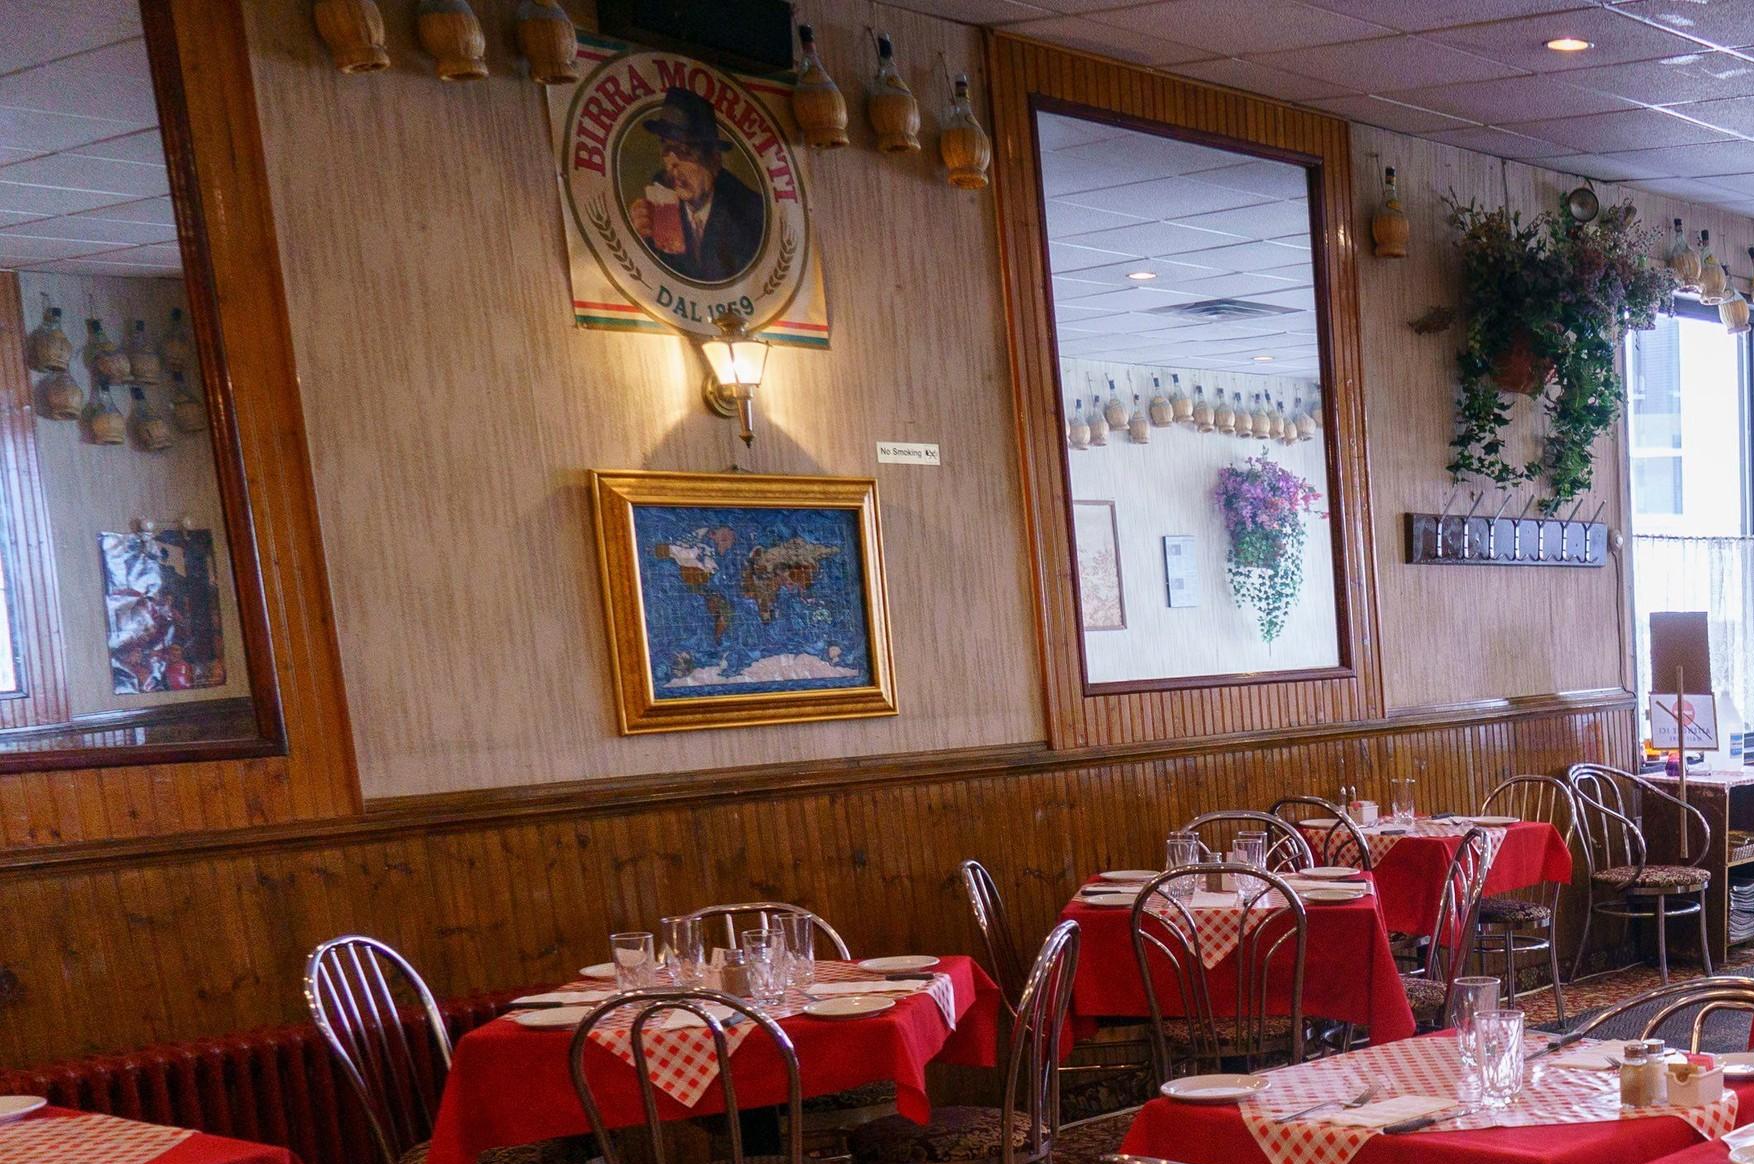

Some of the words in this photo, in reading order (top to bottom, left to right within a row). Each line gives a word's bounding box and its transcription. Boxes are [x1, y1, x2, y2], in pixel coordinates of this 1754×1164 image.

[575, 64, 656, 177] BIRRA
[652, 59, 798, 204] MORETTI
[656, 285, 701, 322] DAL
[880, 447, 892, 456] No
[893, 447, 922, 459] Smoking
